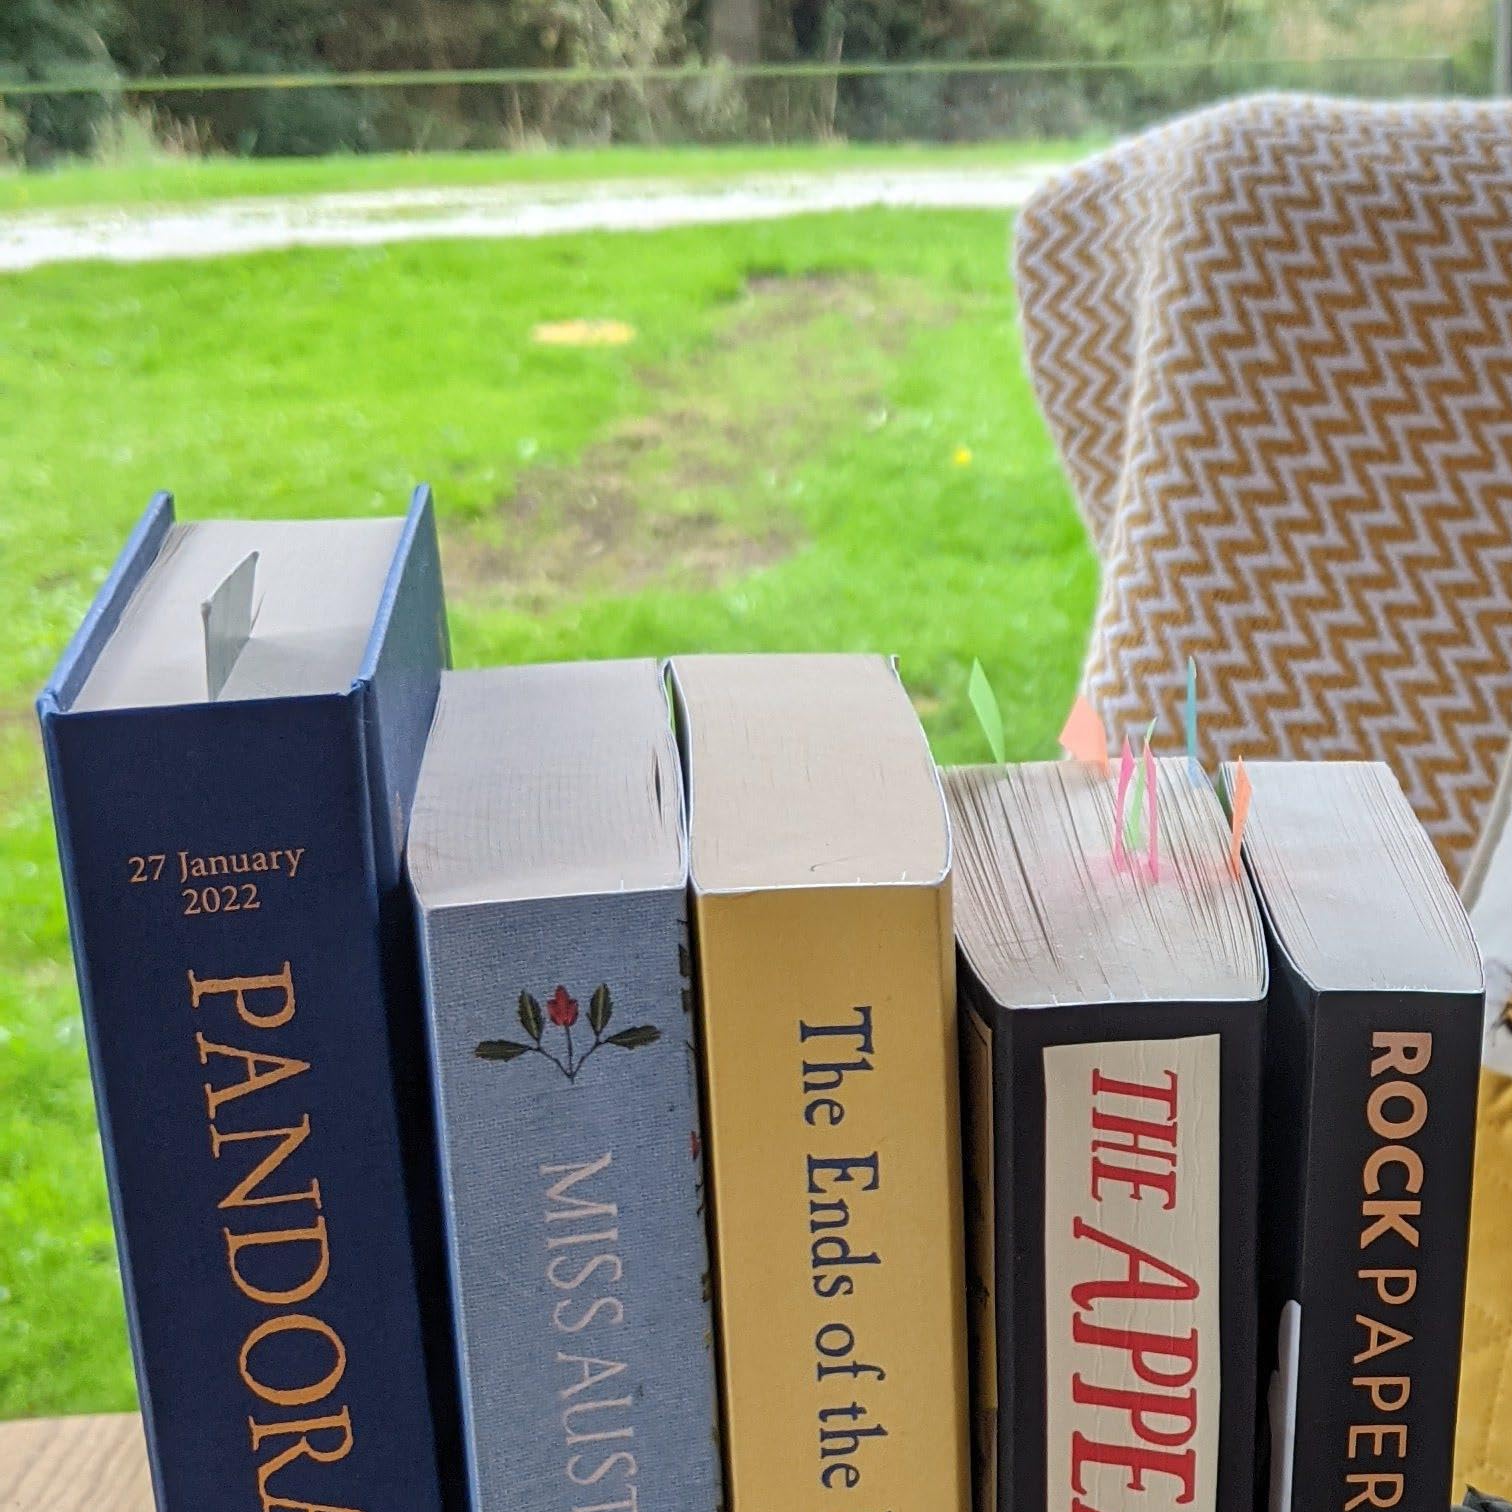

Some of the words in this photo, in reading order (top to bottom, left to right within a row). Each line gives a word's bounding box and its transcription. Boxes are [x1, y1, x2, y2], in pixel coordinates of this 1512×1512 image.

[128, 854, 166, 884] 27
[178, 847, 306, 885] January
[182, 884, 261, 916] 2022
[799, 1005, 877, 1129] The
[1090, 1067, 1178, 1211] THE
[1359, 1031, 1433, 1248] ROCK
[540, 1153, 623, 1334] MISS
[806, 1150, 882, 1299] Ends
[815, 1322, 886, 1384] of
[1343, 1269, 1417, 1512] PAPER
[817, 1400, 888, 1491] the
